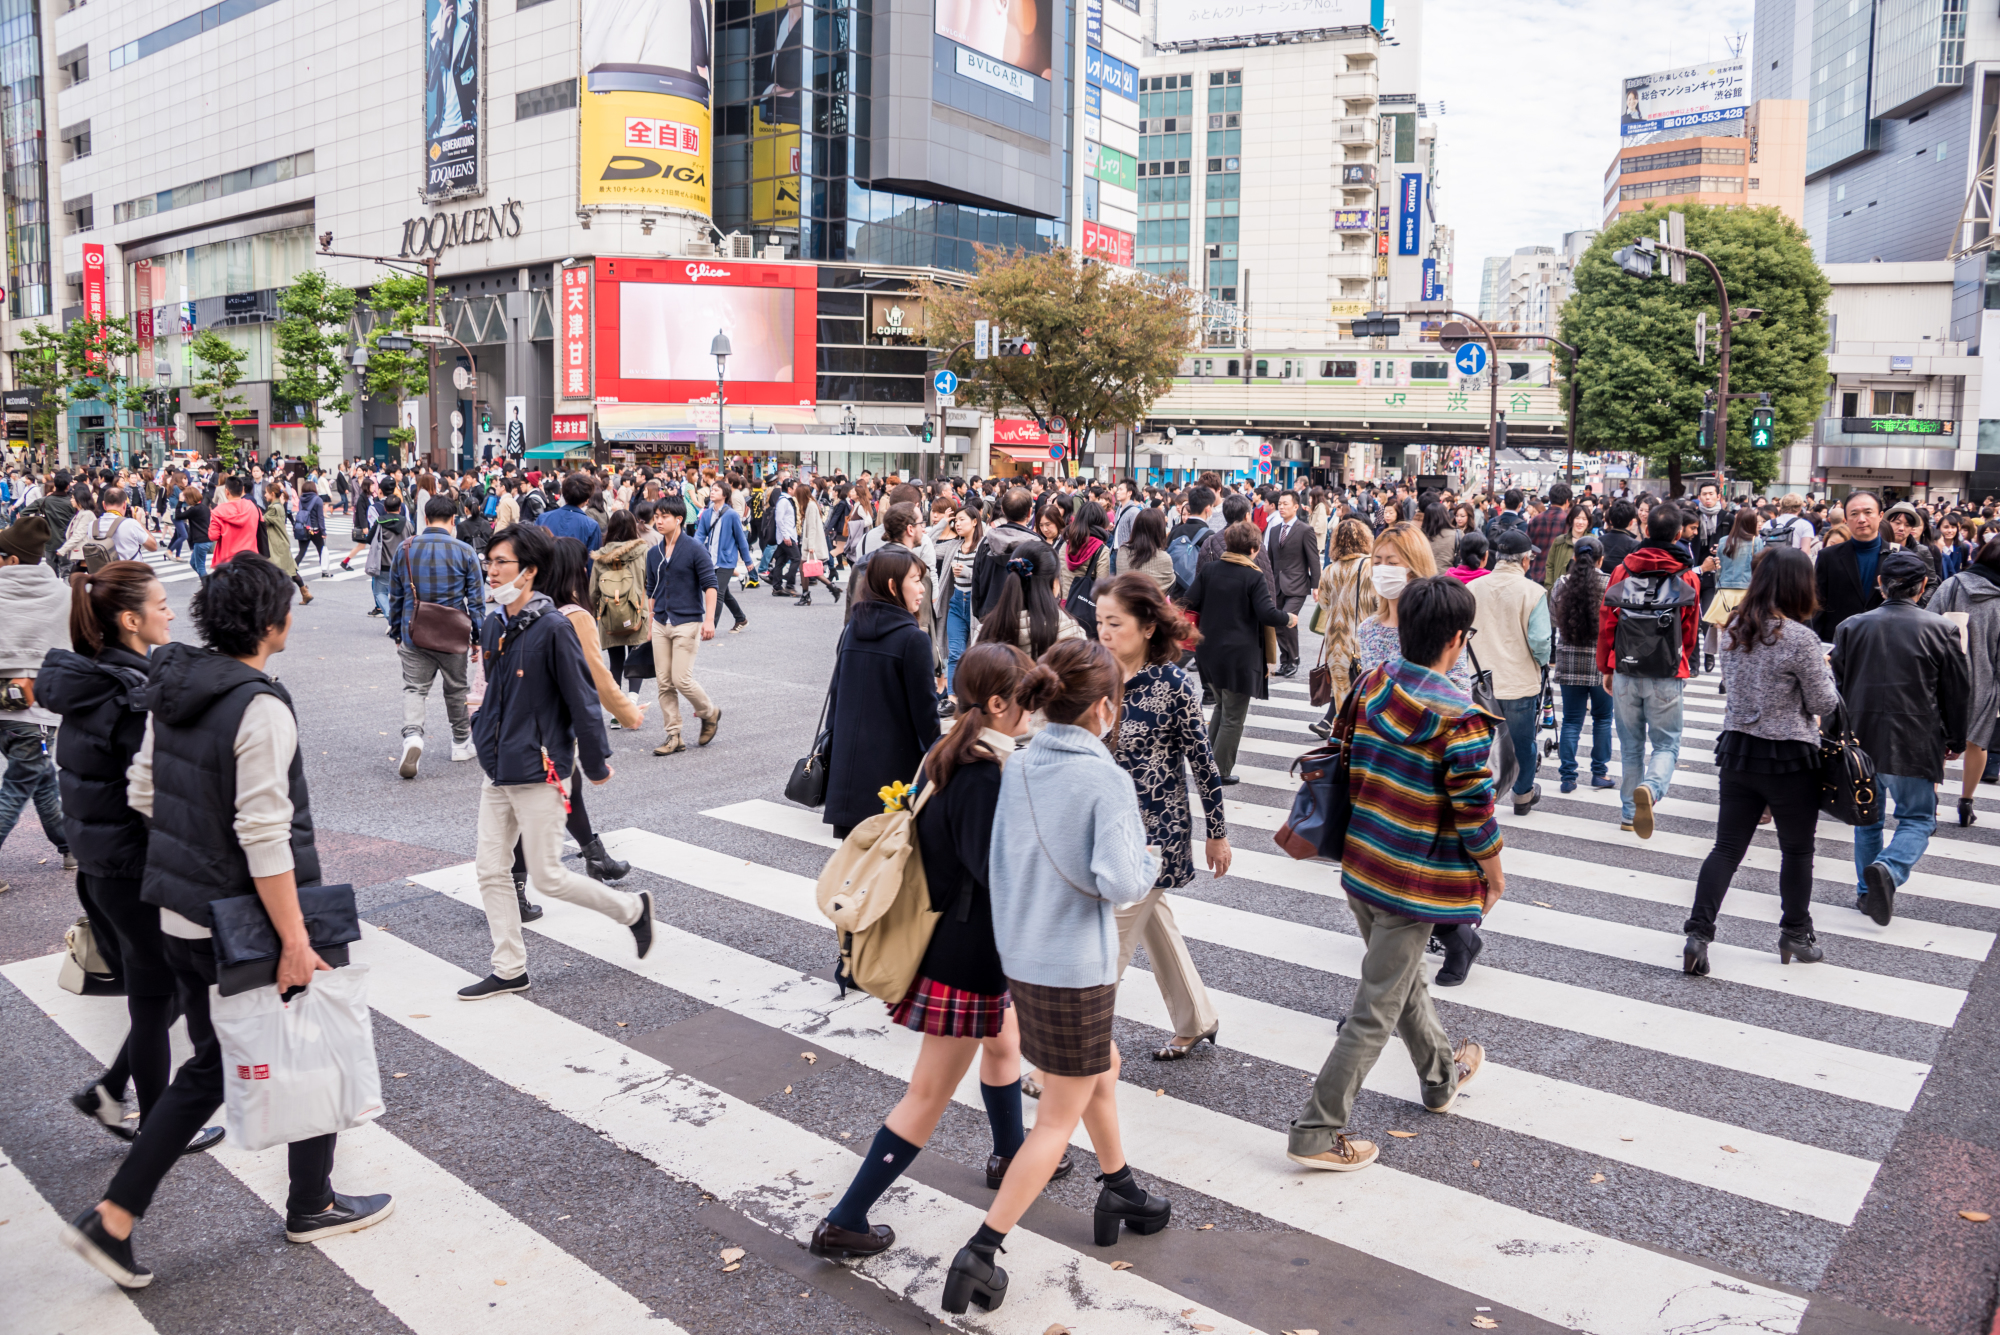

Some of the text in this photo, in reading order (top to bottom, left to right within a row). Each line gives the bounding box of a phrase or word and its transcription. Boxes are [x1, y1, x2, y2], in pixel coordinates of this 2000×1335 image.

[941, 25, 970, 42] BVLGARI
[968, 54, 1023, 86] BVLGARI
[1087, 56, 1133, 94] レオパレス21
[1641, 76, 1743, 100] 総合マンションギャラリー
[1714, 87, 1743, 101] 渋谷館
[1675, 107, 1744, 127] 0120-553-428
[442, 134, 475, 152] GENERATIONS
[628, 121, 698, 152] 全自動
[429, 160, 475, 188] 109MEN'S
[599, 155, 705, 187] DIGA
[1100, 155, 1120, 175] レイク
[1407, 178, 1417, 213] MIZUHO
[397, 196, 524, 263] 109MEN'S
[1405, 217, 1414, 250] みずほ銀行
[1086, 229, 1118, 255] アコム
[565, 270, 587, 286] 名物
[685, 263, 731, 282] Glico
[1425, 267, 1435, 299] MIZUHO
[876, 326, 914, 335] COFFEE
[891, 316, 900, 326] H
[567, 287, 584, 394] 天津甘栗
[1385, 392, 1531, 413] JR 渋谷
[554, 420, 587, 434] 天津甘栗
[616, 432, 670, 440] SANZENRI
